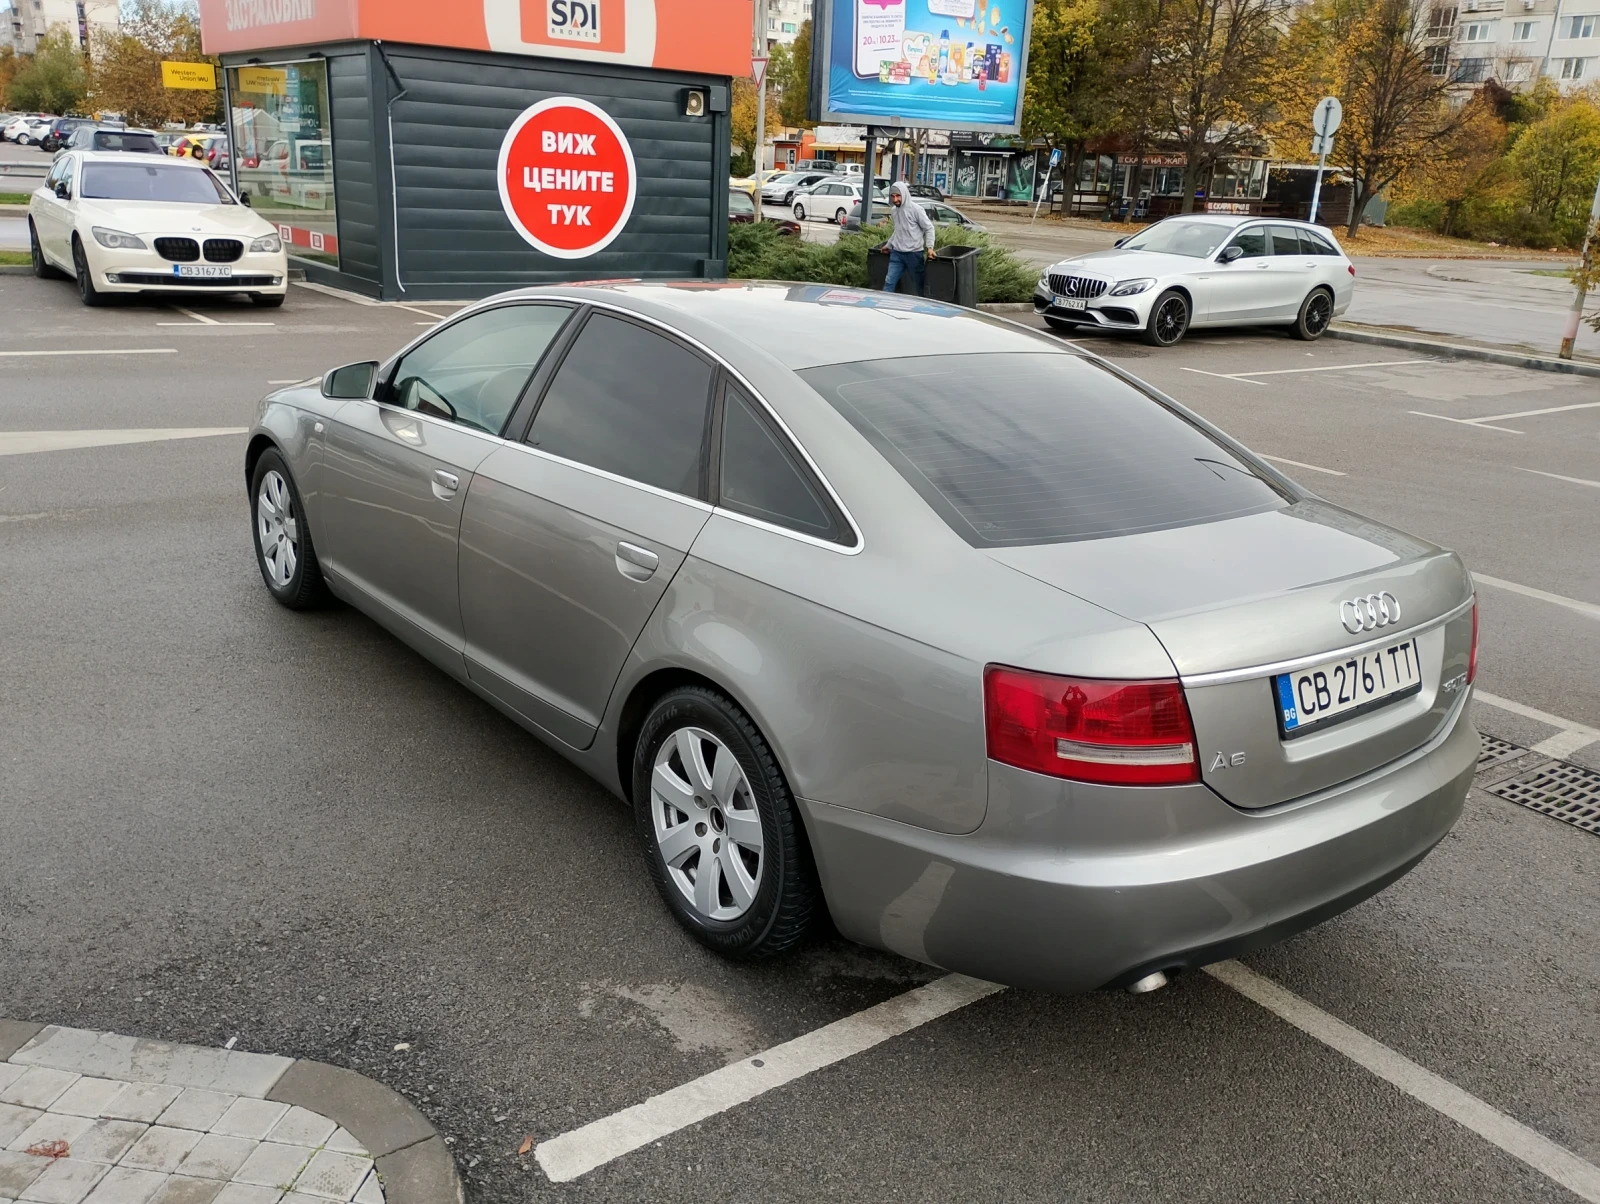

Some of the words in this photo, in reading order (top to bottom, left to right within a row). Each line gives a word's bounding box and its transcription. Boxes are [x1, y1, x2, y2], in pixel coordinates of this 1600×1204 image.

[551, 0, 597, 30] SDI
[551, 27, 597, 38] BROKER
[541, 130, 597, 156] ВИЖ
[1124, 156, 1149, 164] СКАА
[523, 166, 615, 193] ЦЕНИТЕ
[547, 203, 592, 226] ТУК
[180, 266, 193, 276] CB
[194, 266, 216, 276] 3167
[218, 267, 230, 276] XC
[1062, 299, 1075, 308] 7762
[1298, 671, 1331, 715] CB
[1334, 652, 1385, 704] 2761
[1387, 642, 1412, 683] TT
[1284, 709, 1296, 721] BG
[1208, 751, 1246, 773] A6
